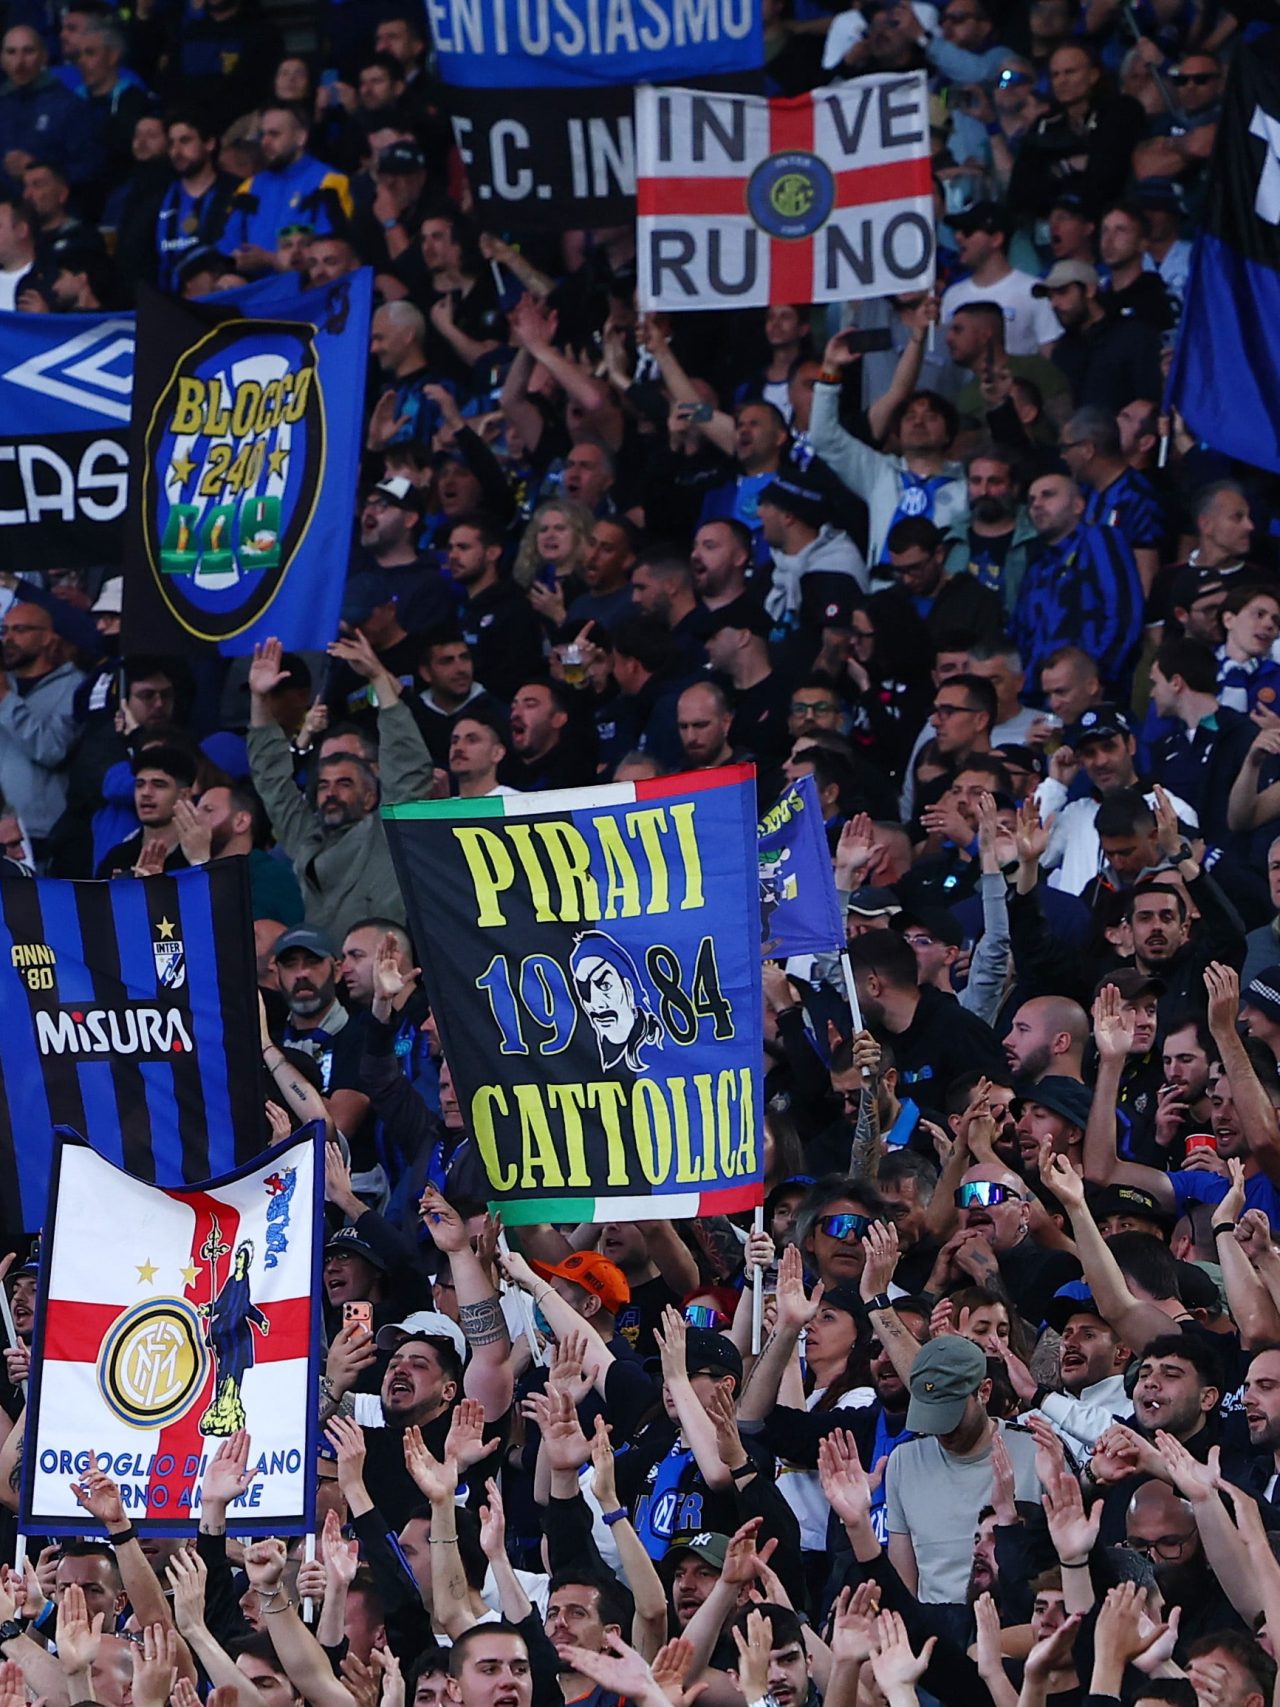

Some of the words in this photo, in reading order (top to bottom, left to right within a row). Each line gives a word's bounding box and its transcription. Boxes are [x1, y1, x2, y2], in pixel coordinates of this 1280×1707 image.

[658, 96, 745, 162] IN
[825, 77, 923, 155] VE
[650, 228, 757, 297] RU
[826, 211, 932, 289] NO
[170, 366, 314, 438] BLOCCO
[200, 438, 266, 496] 240
[452, 801, 706, 928] PIRATI
[155, 941, 182, 954] INTER
[471, 1067, 758, 1192] CATTOLICA
[39, 1447, 176, 1478] ORGOGLIO
[183, 1453, 209, 1478] DI
